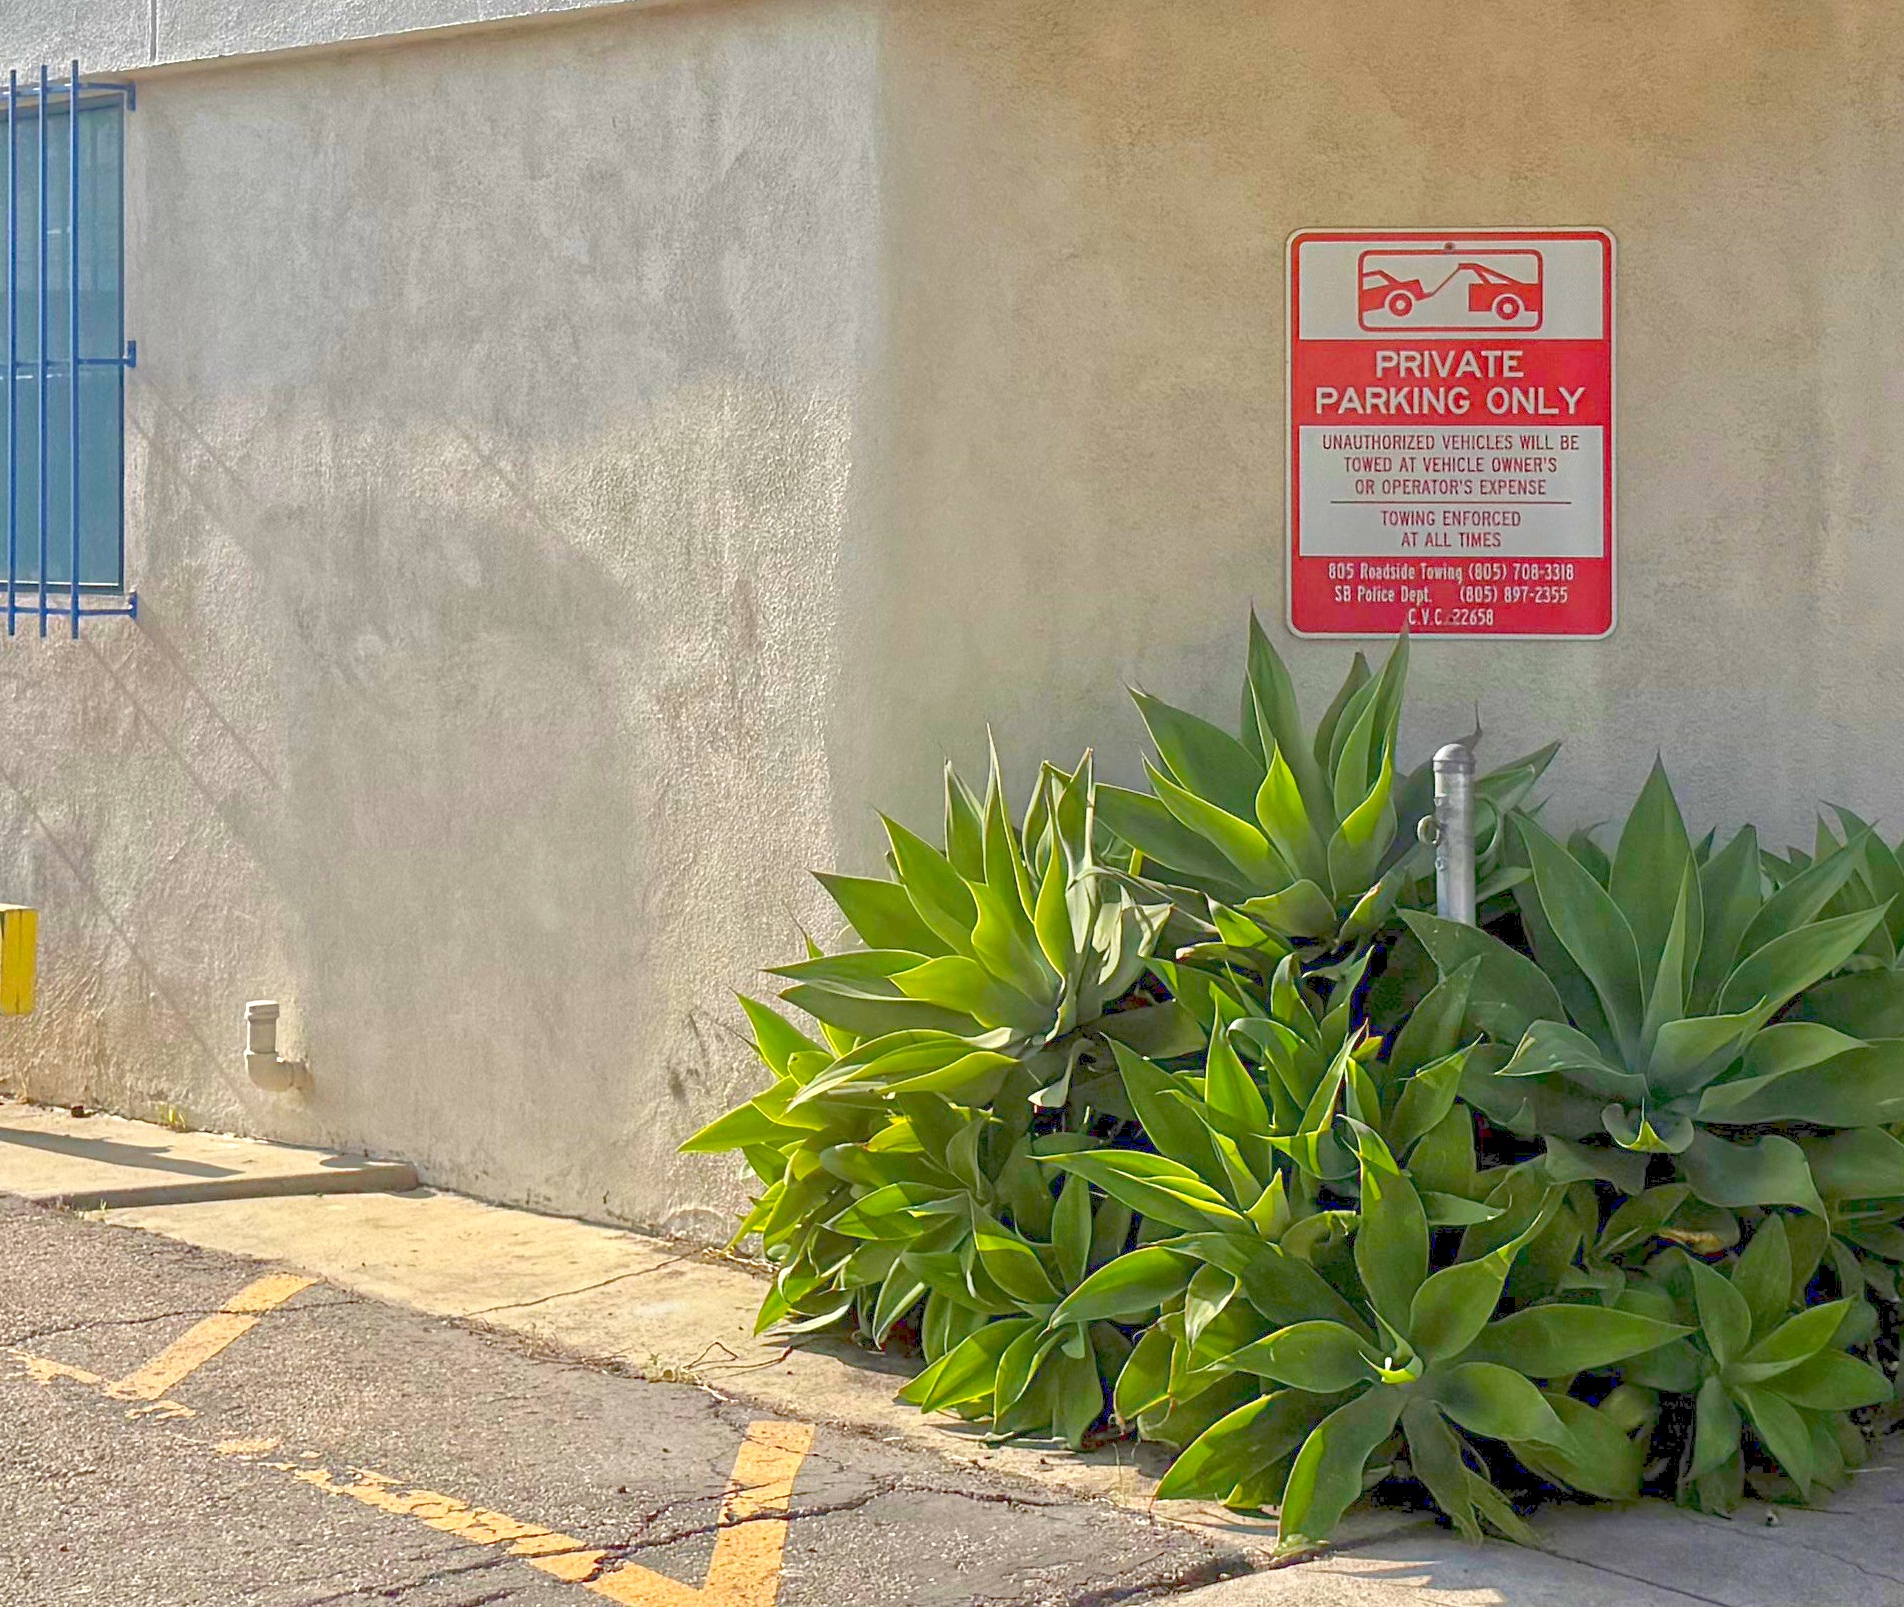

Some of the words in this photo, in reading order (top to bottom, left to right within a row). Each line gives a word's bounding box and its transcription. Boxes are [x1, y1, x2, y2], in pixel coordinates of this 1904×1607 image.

[1375, 350, 1525, 379] PRIVATE
[1314, 387, 1471, 415] PARKING
[1486, 387, 1586, 415] ONLY
[1322, 434, 1435, 451] UNAUTHORIZED
[1441, 434, 1514, 451] VEHICLES
[1519, 435, 1555, 451] WILL
[1559, 435, 1580, 451] BE
[1344, 456, 1393, 473] TOWED
[1399, 456, 1417, 473] AT
[1422, 456, 1485, 473] VEHICLE
[1491, 456, 1558, 473] OWNER'S
[1355, 478, 1375, 495] OR
[1382, 478, 1473, 495] OPERATOR'S
[1479, 478, 1547, 495] EXPENSE
[1380, 510, 1436, 527] TOWING
[1442, 510, 1522, 527] ENFORCED
[1400, 531, 1418, 547] AT
[1424, 531, 1452, 547] ALL
[1458, 531, 1502, 548] TIMES
[1328, 562, 1355, 580] 805
[1360, 562, 1415, 580] Roadside
[1420, 562, 1463, 585] Towing
[1468, 562, 1508, 581] (805)
[1334, 584, 1352, 602] SB
[1357, 584, 1395, 602] Police
[1400, 584, 1433, 606] Dept.
[1459, 585, 1498, 603] (805)
[1503, 585, 1569, 603] 897-2355
